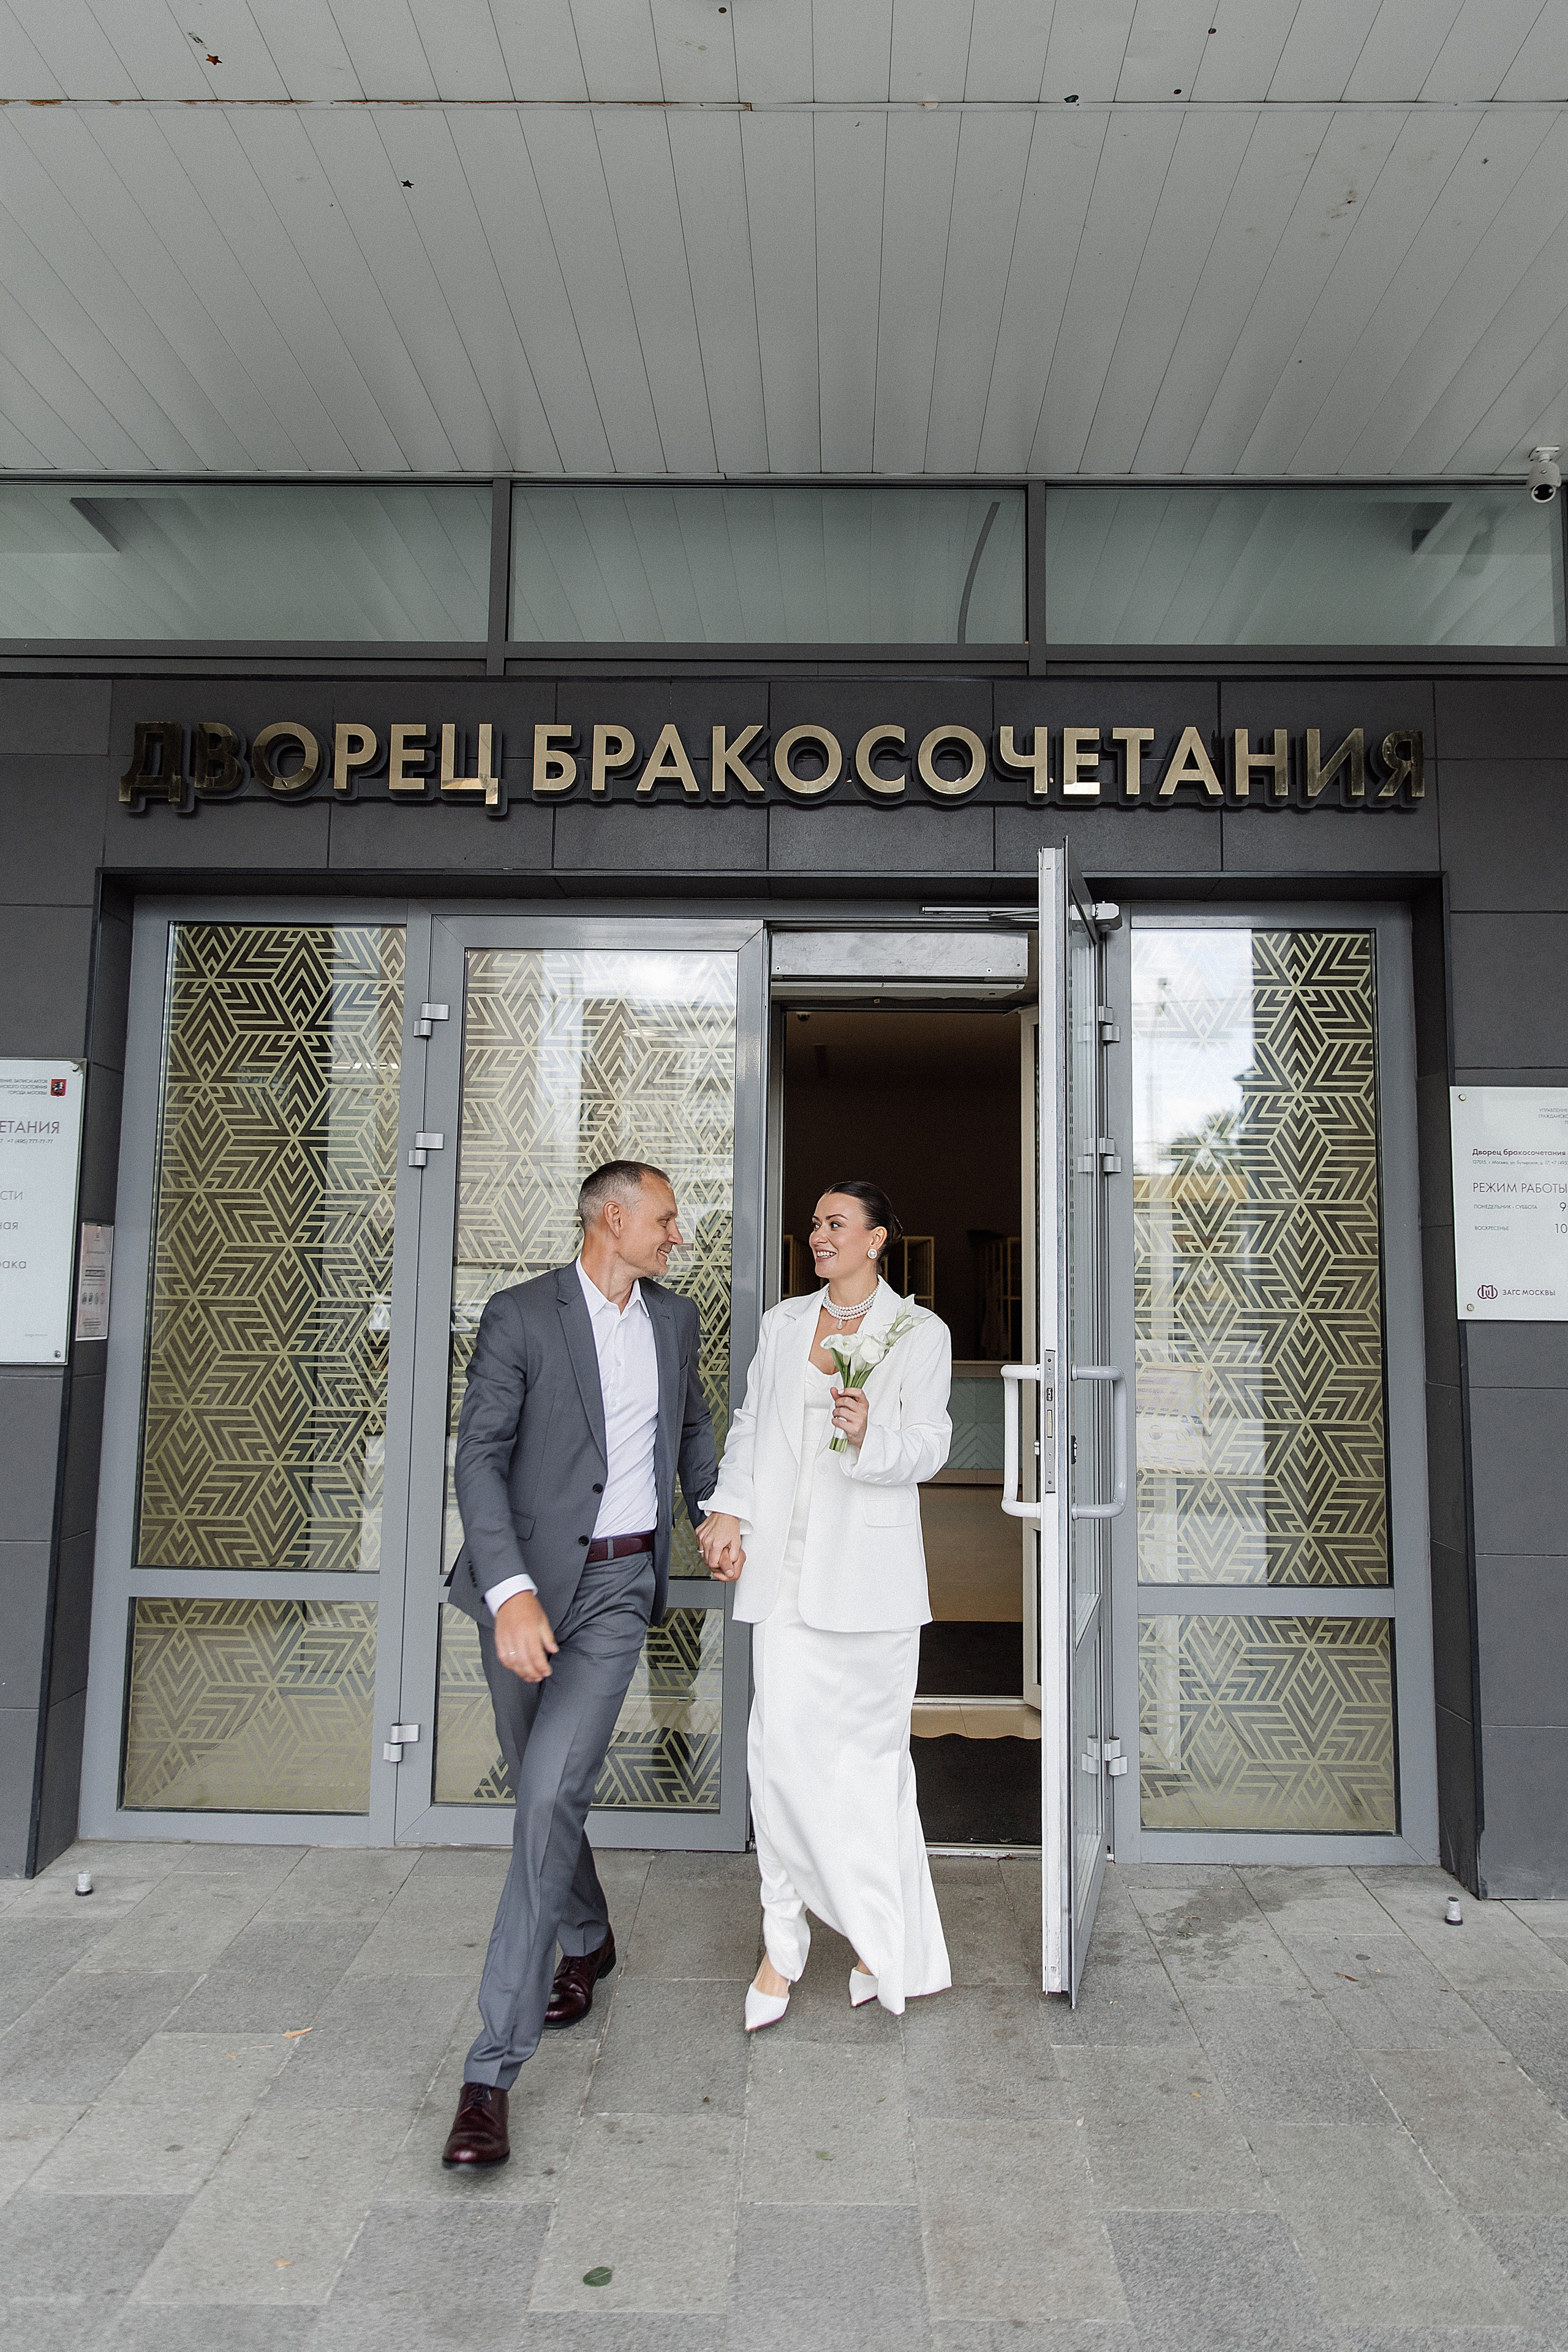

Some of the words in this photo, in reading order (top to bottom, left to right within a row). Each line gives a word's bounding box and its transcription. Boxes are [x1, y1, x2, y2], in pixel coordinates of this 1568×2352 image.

[118, 722, 499, 804] ДВОРЕЦ
[533, 723, 1425, 798] БРАКОСОЧЕТАНИЯ
[1472, 1148, 1502, 1157] Дворец
[1503, 1148, 1566, 1157] бракосочетания
[1473, 1182, 1517, 1193] РЕЖИМ
[1521, 1183, 1567, 1193] РАБОТЫ
